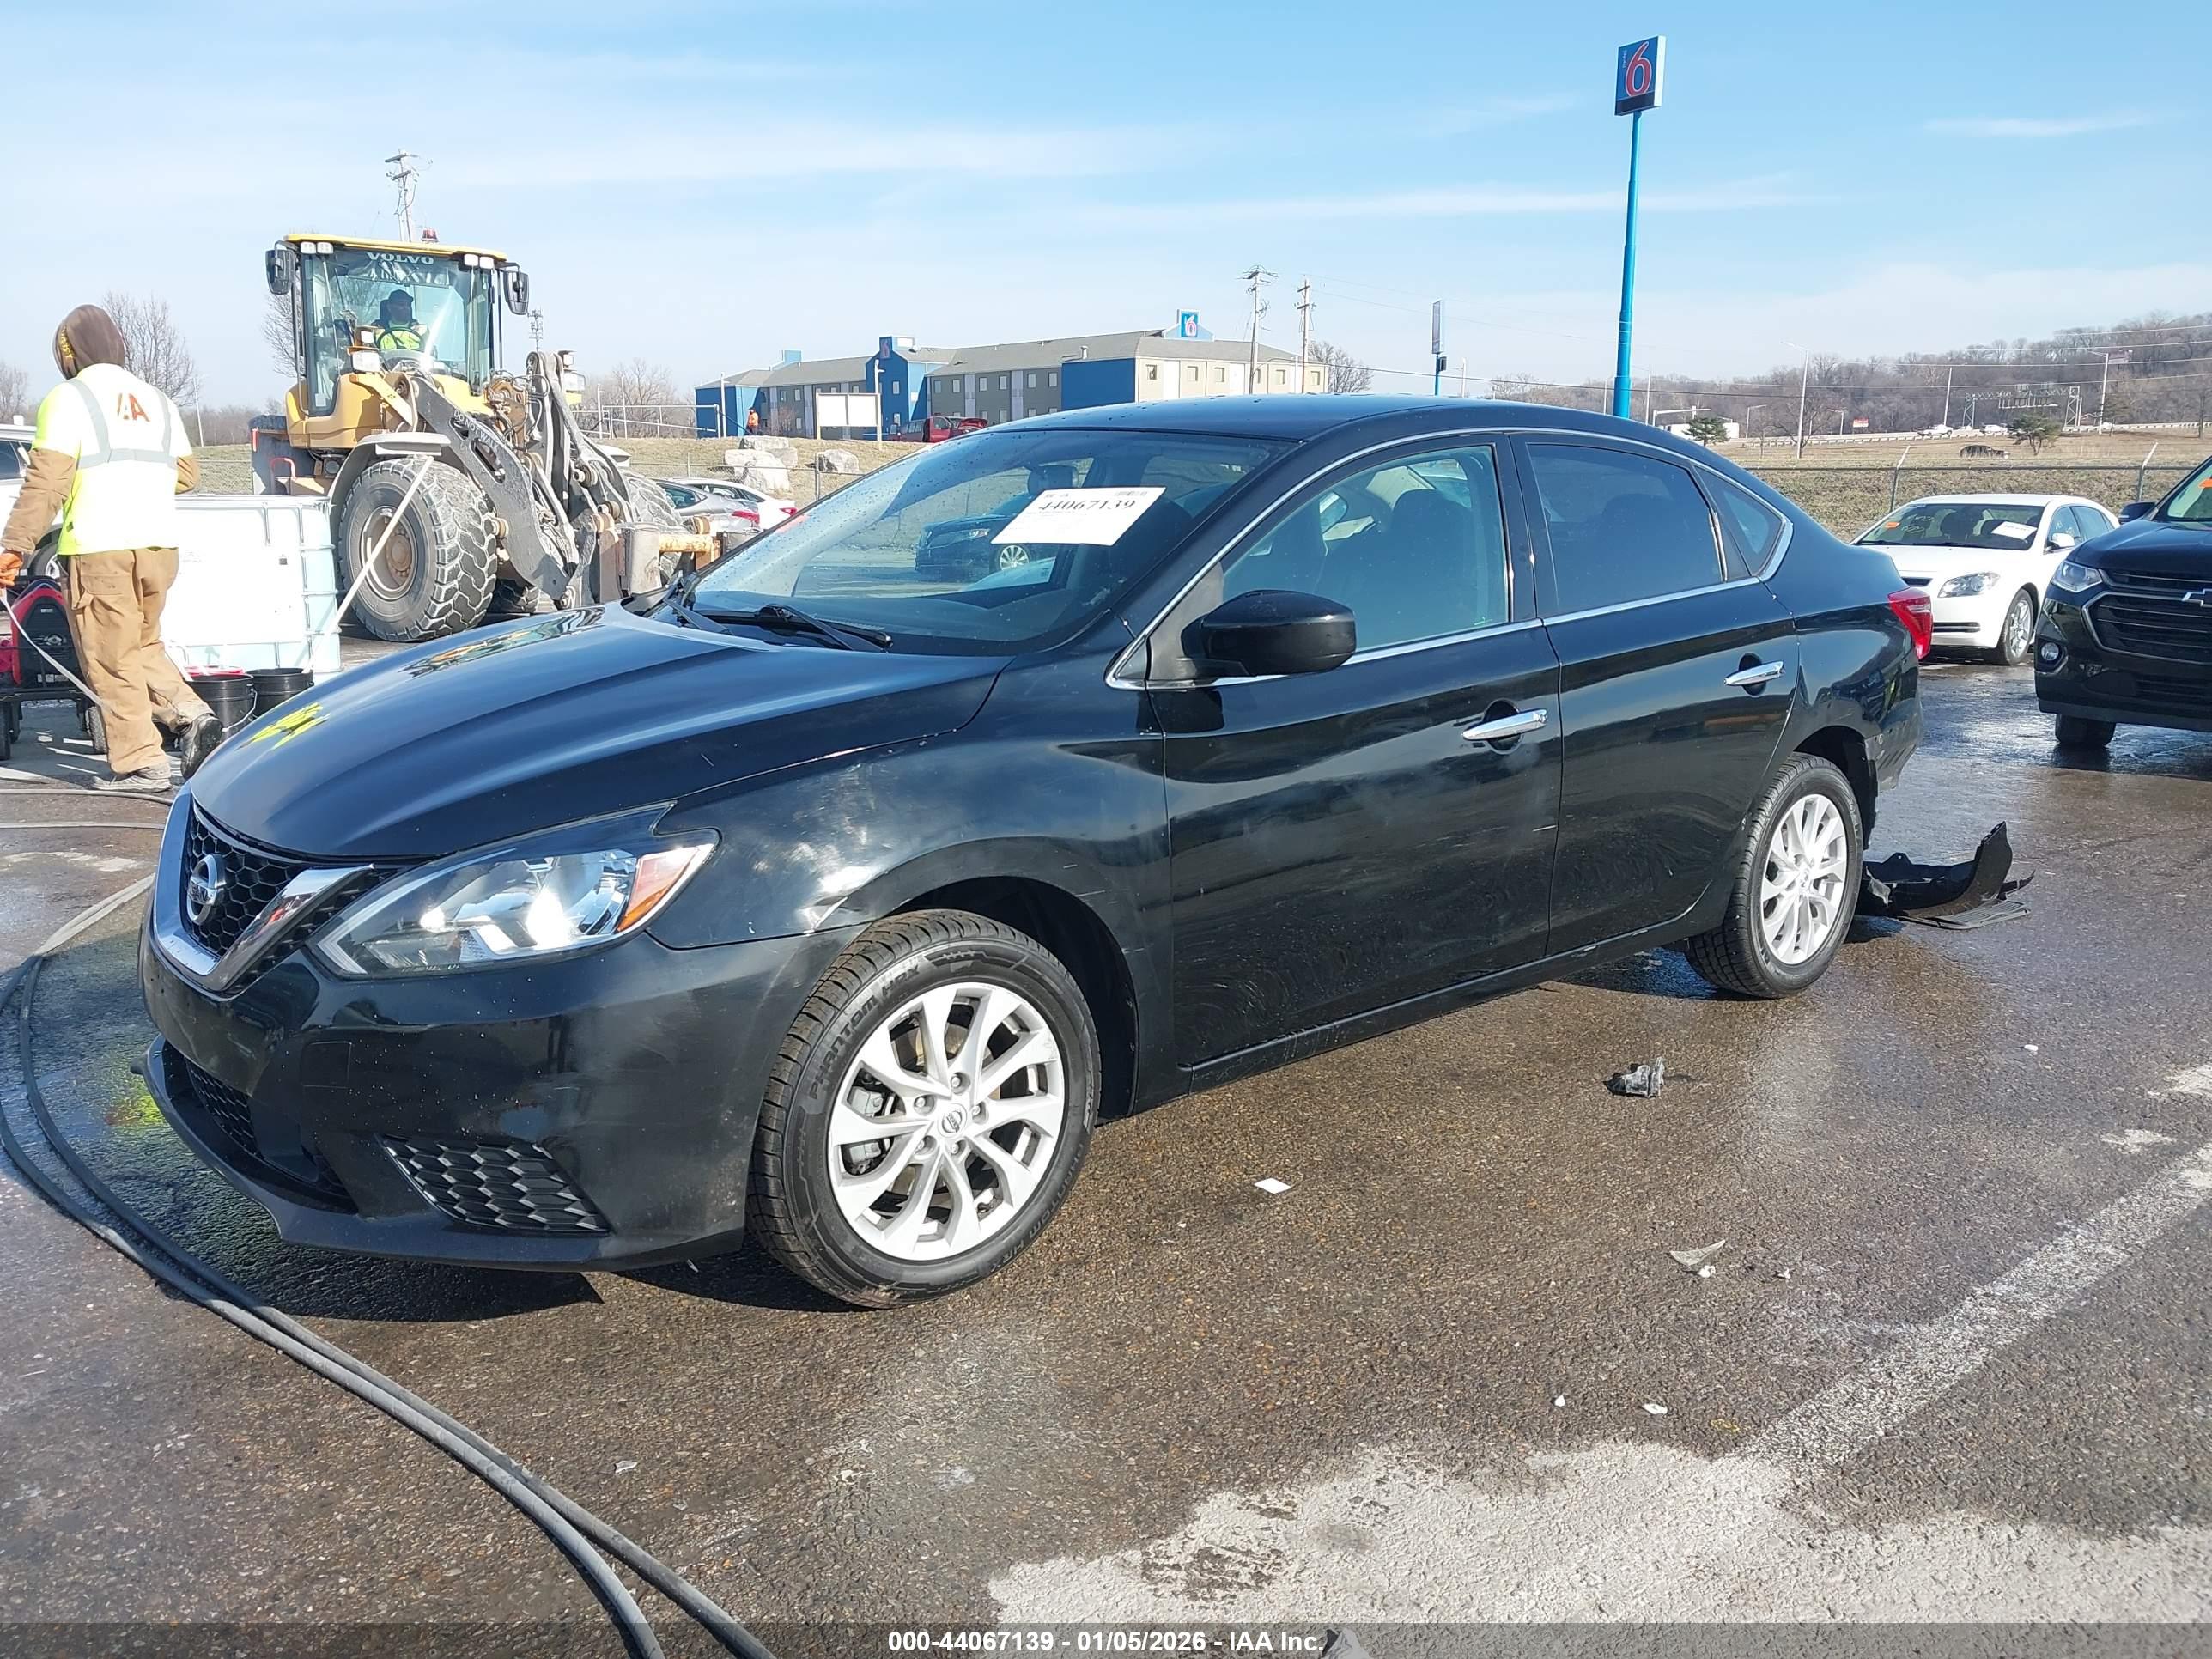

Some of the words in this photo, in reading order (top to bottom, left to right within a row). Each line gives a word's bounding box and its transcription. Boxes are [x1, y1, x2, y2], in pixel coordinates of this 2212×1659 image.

[1625, 40, 1652, 97] 6
[367, 252, 434, 264] VOLVO
[453, 409, 465, 421] DO
[465, 418, 479, 434] NOT
[480, 430, 498, 453] WALK
